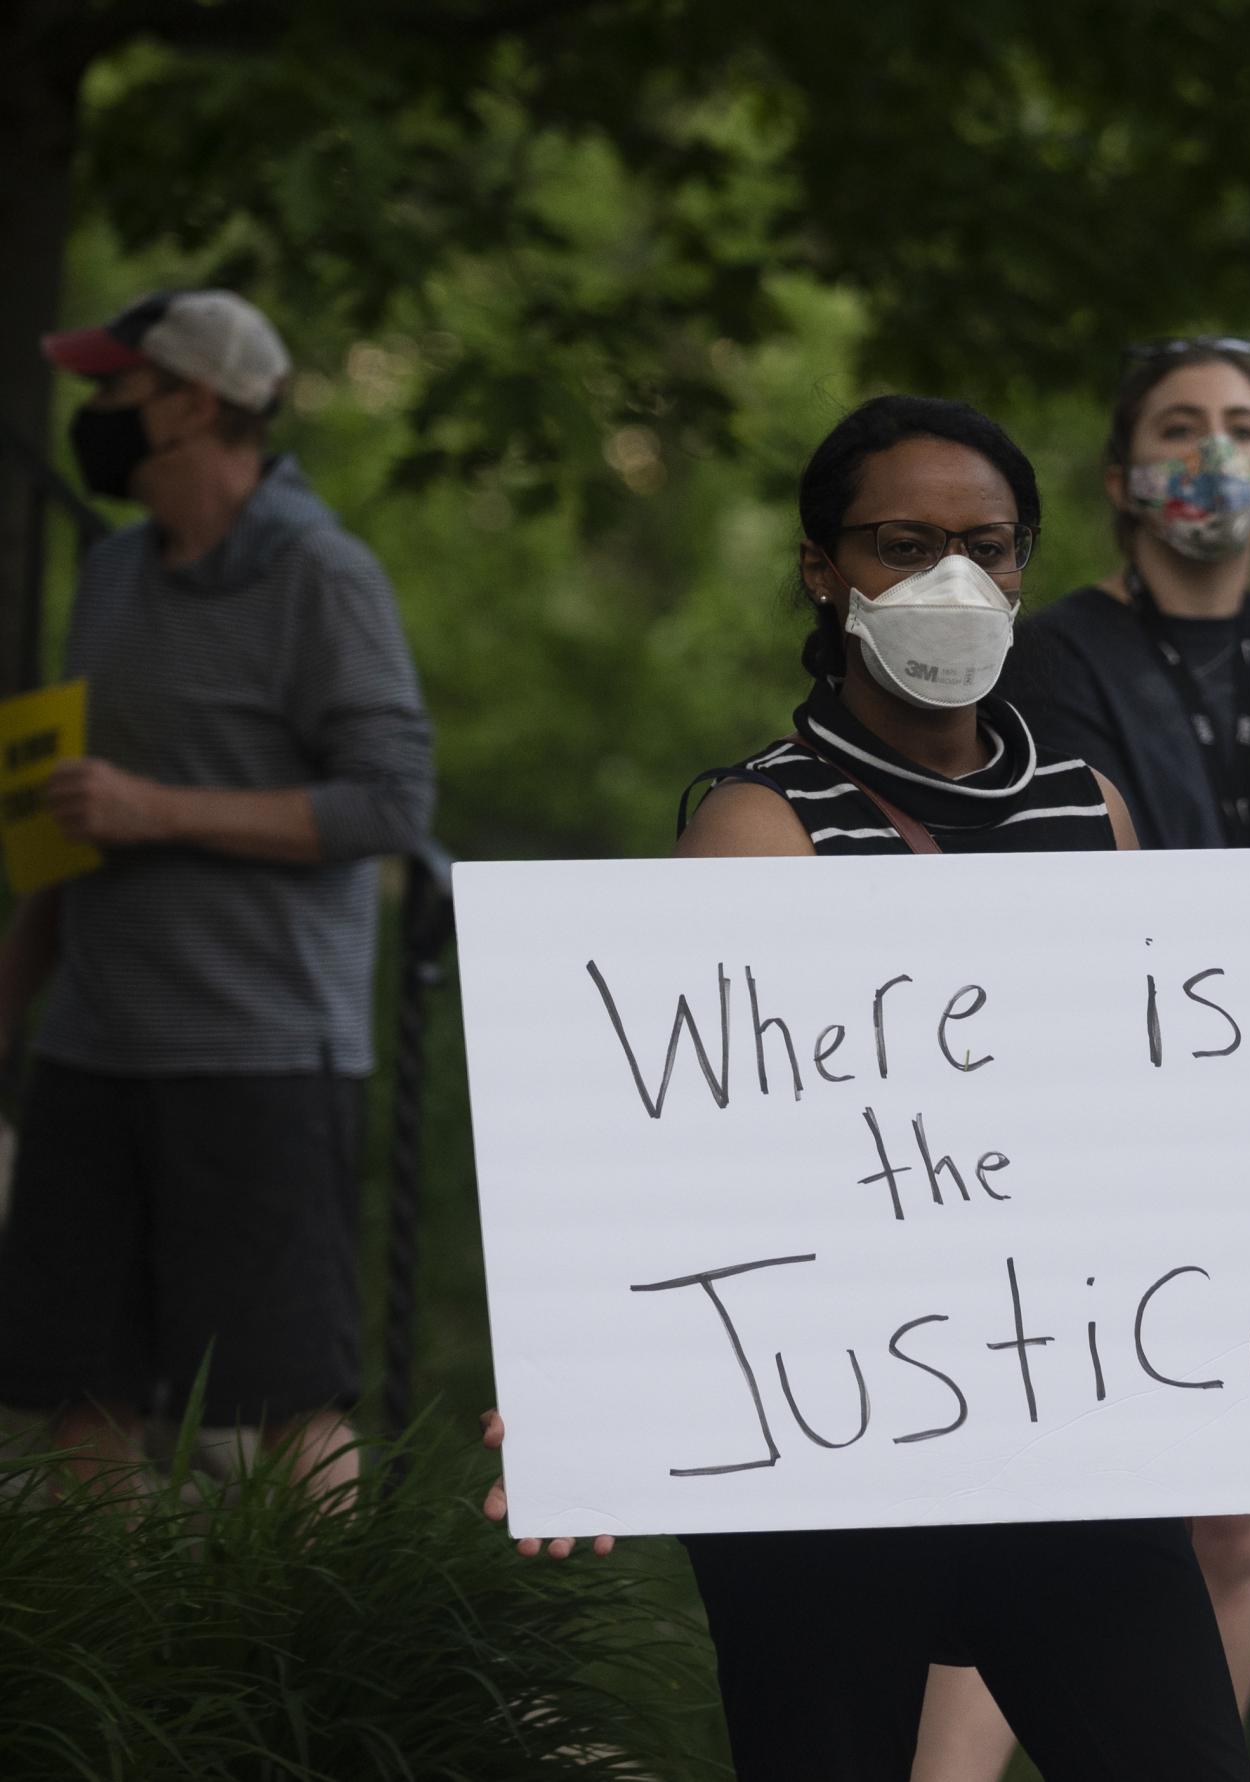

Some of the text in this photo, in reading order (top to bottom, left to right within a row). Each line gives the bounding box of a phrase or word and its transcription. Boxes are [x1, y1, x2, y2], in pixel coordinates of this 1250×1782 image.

[904, 659, 939, 683] 3M
[585, 937, 1242, 1120] Where is
[857, 1106, 1012, 1221] the
